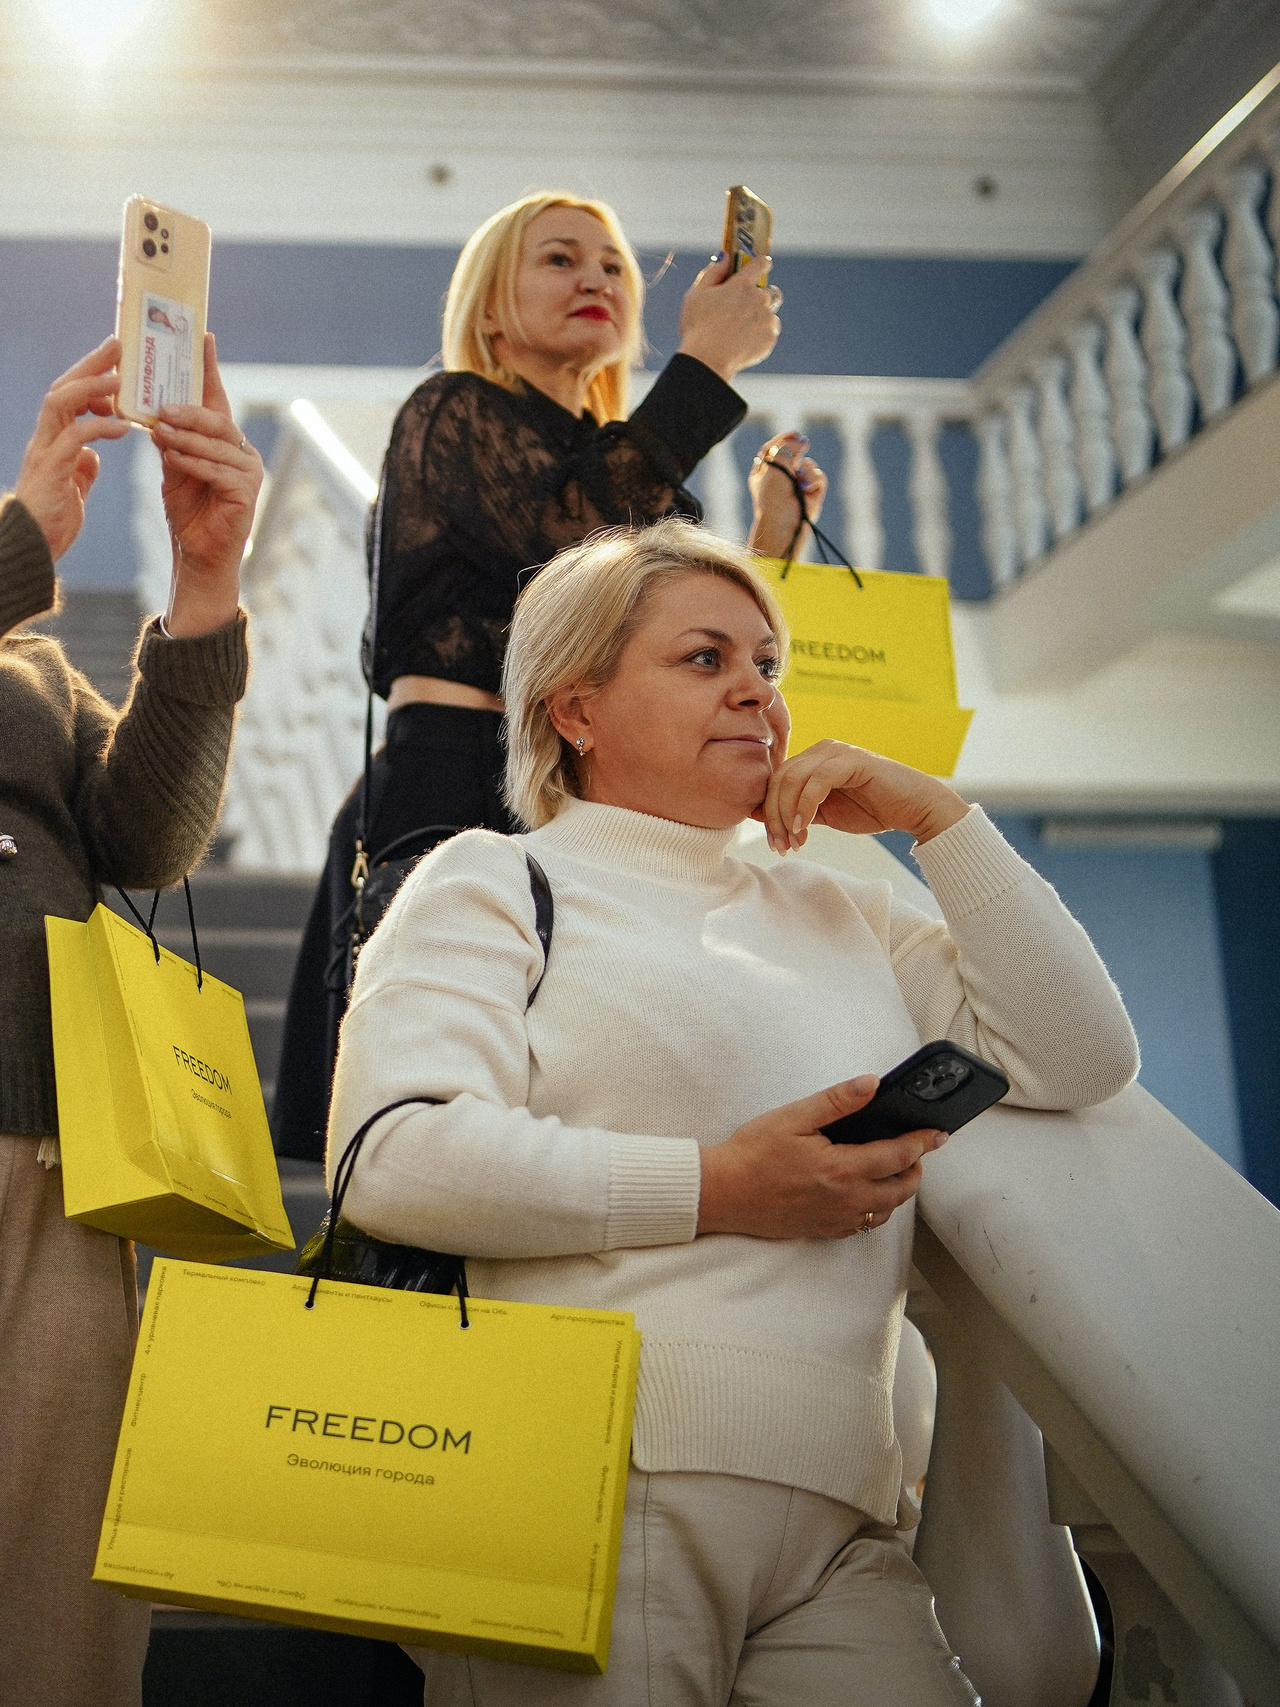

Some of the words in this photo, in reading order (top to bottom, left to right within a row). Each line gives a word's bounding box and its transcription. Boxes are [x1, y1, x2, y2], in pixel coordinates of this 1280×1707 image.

[142, 336, 156, 407] ЖИЛФОНД
[790, 638, 887, 666] REEDOM
[172, 1044, 233, 1096] FREEDOM
[156, 1265, 168, 1300] парковка
[182, 1268, 228, 1281] Термальный
[229, 1275, 266, 1286] комплекс
[291, 1283, 343, 1297] Апараменты
[351, 1292, 392, 1303] пентхаусы
[265, 1404, 472, 1454] FREEDOM
[286, 1453, 371, 1477] Эволюция
[375, 1467, 435, 1485] города
